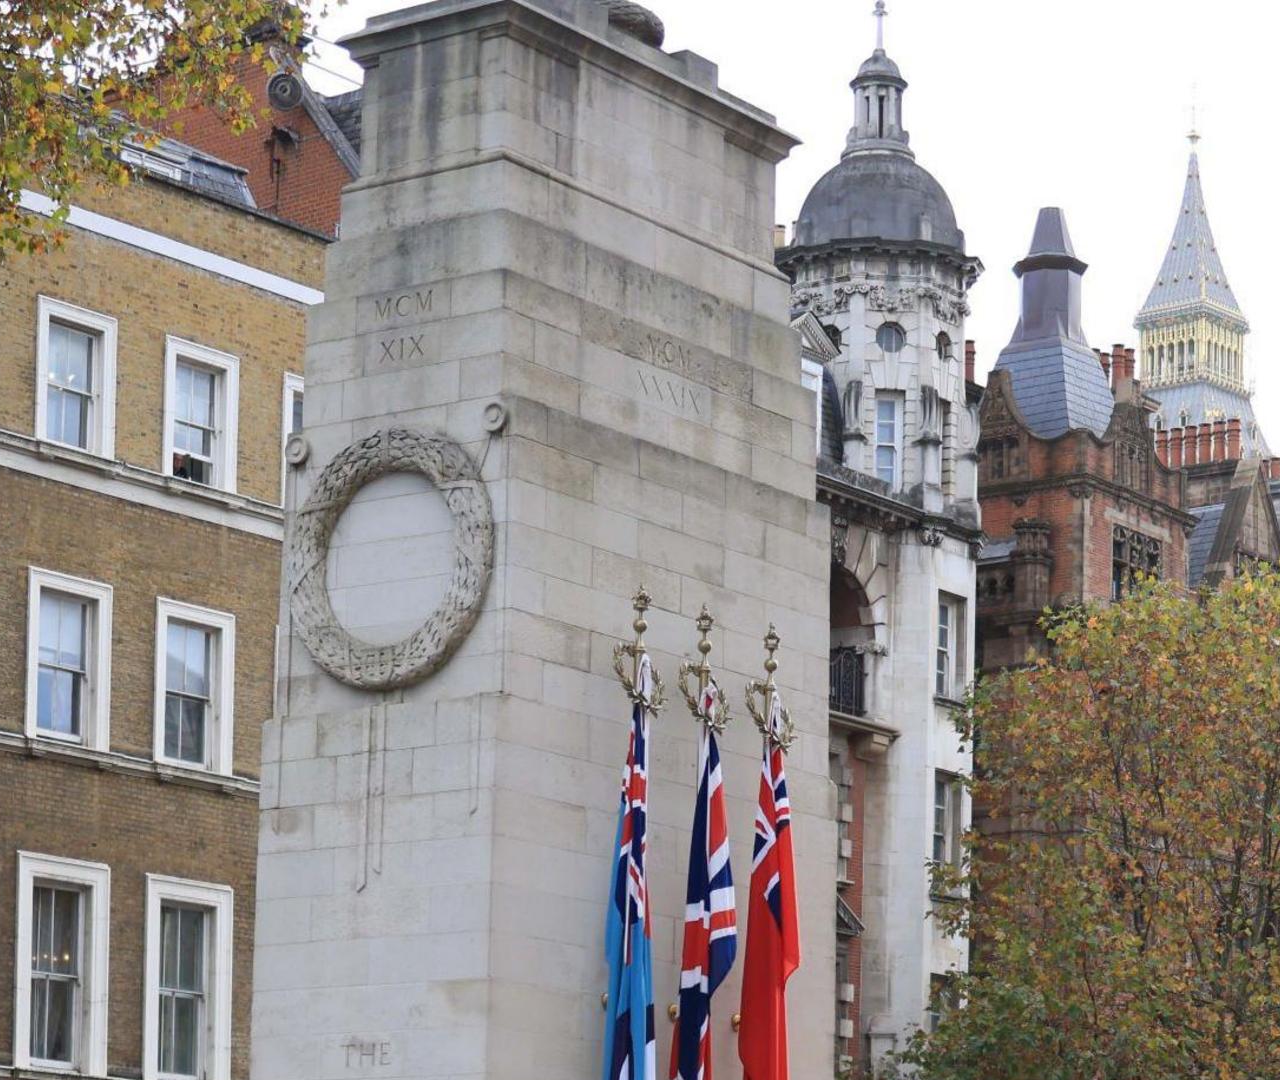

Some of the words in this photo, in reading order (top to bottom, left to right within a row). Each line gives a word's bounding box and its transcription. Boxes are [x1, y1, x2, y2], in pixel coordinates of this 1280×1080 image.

[375, 288, 433, 321] MCM
[379, 333, 425, 364] XIX
[339, 1041, 392, 1069] THE
